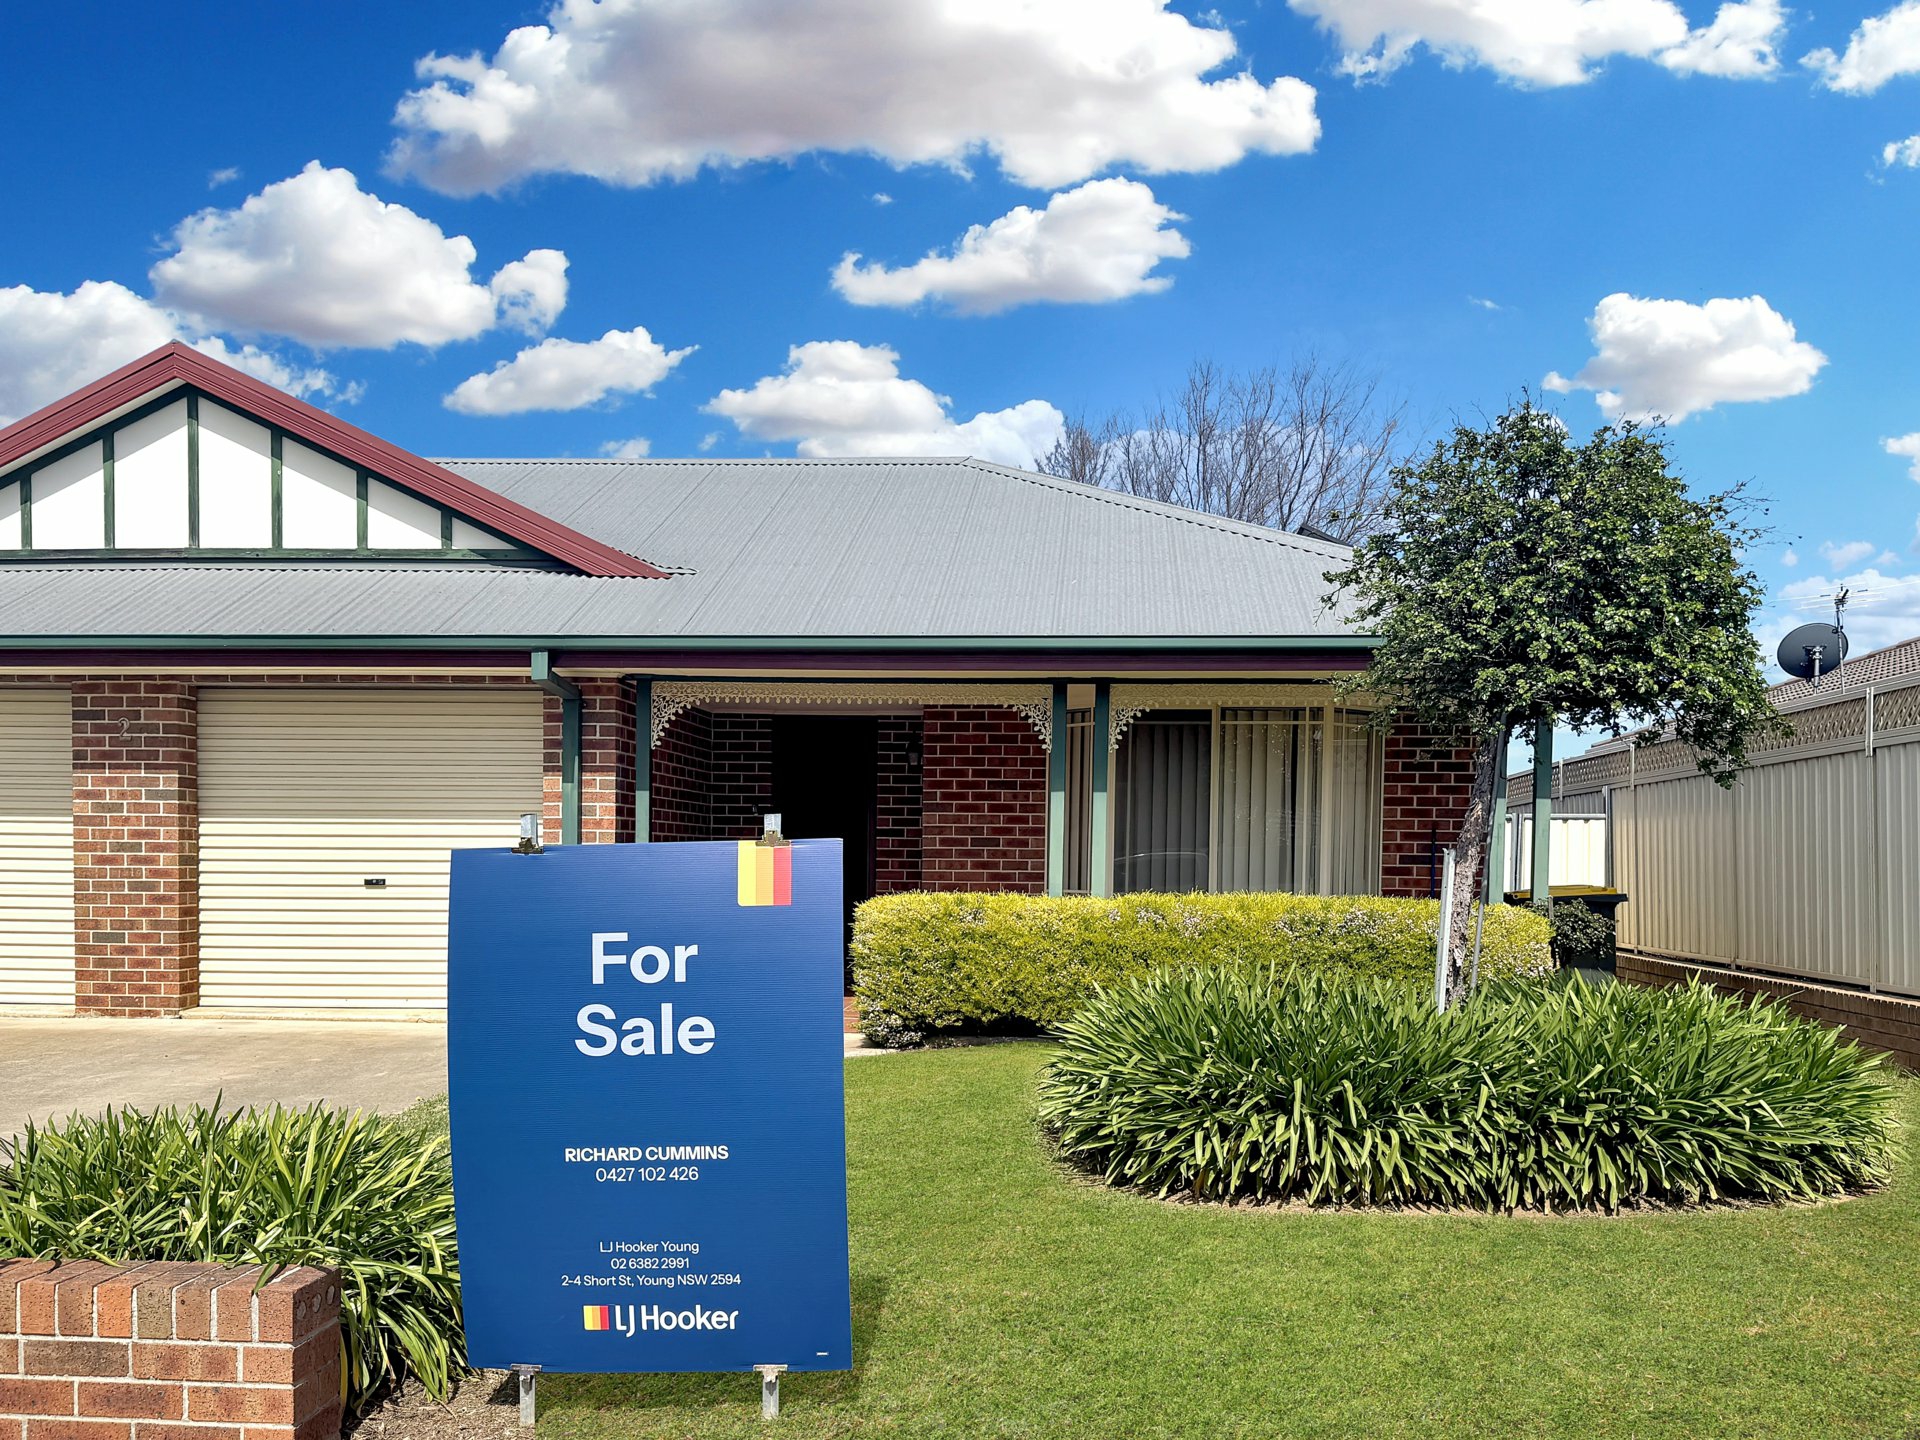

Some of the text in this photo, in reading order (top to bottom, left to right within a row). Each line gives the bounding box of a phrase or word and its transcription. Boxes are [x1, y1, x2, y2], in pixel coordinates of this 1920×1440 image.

[117, 717, 132, 742] 2
[591, 932, 700, 985] For
[574, 1002, 716, 1057] Sale
[564, 1145, 729, 1162] RICHARD CUMMINS
[595, 1166, 699, 1183] 0427 102 426
[599, 1241, 700, 1255] LJ Hooker Young
[610, 1257, 690, 1270] 02 6382 2991
[561, 1273, 741, 1289] 2-4 Short St, Young NSW 2594
[614, 1304, 739, 1338] LJ Hooker
